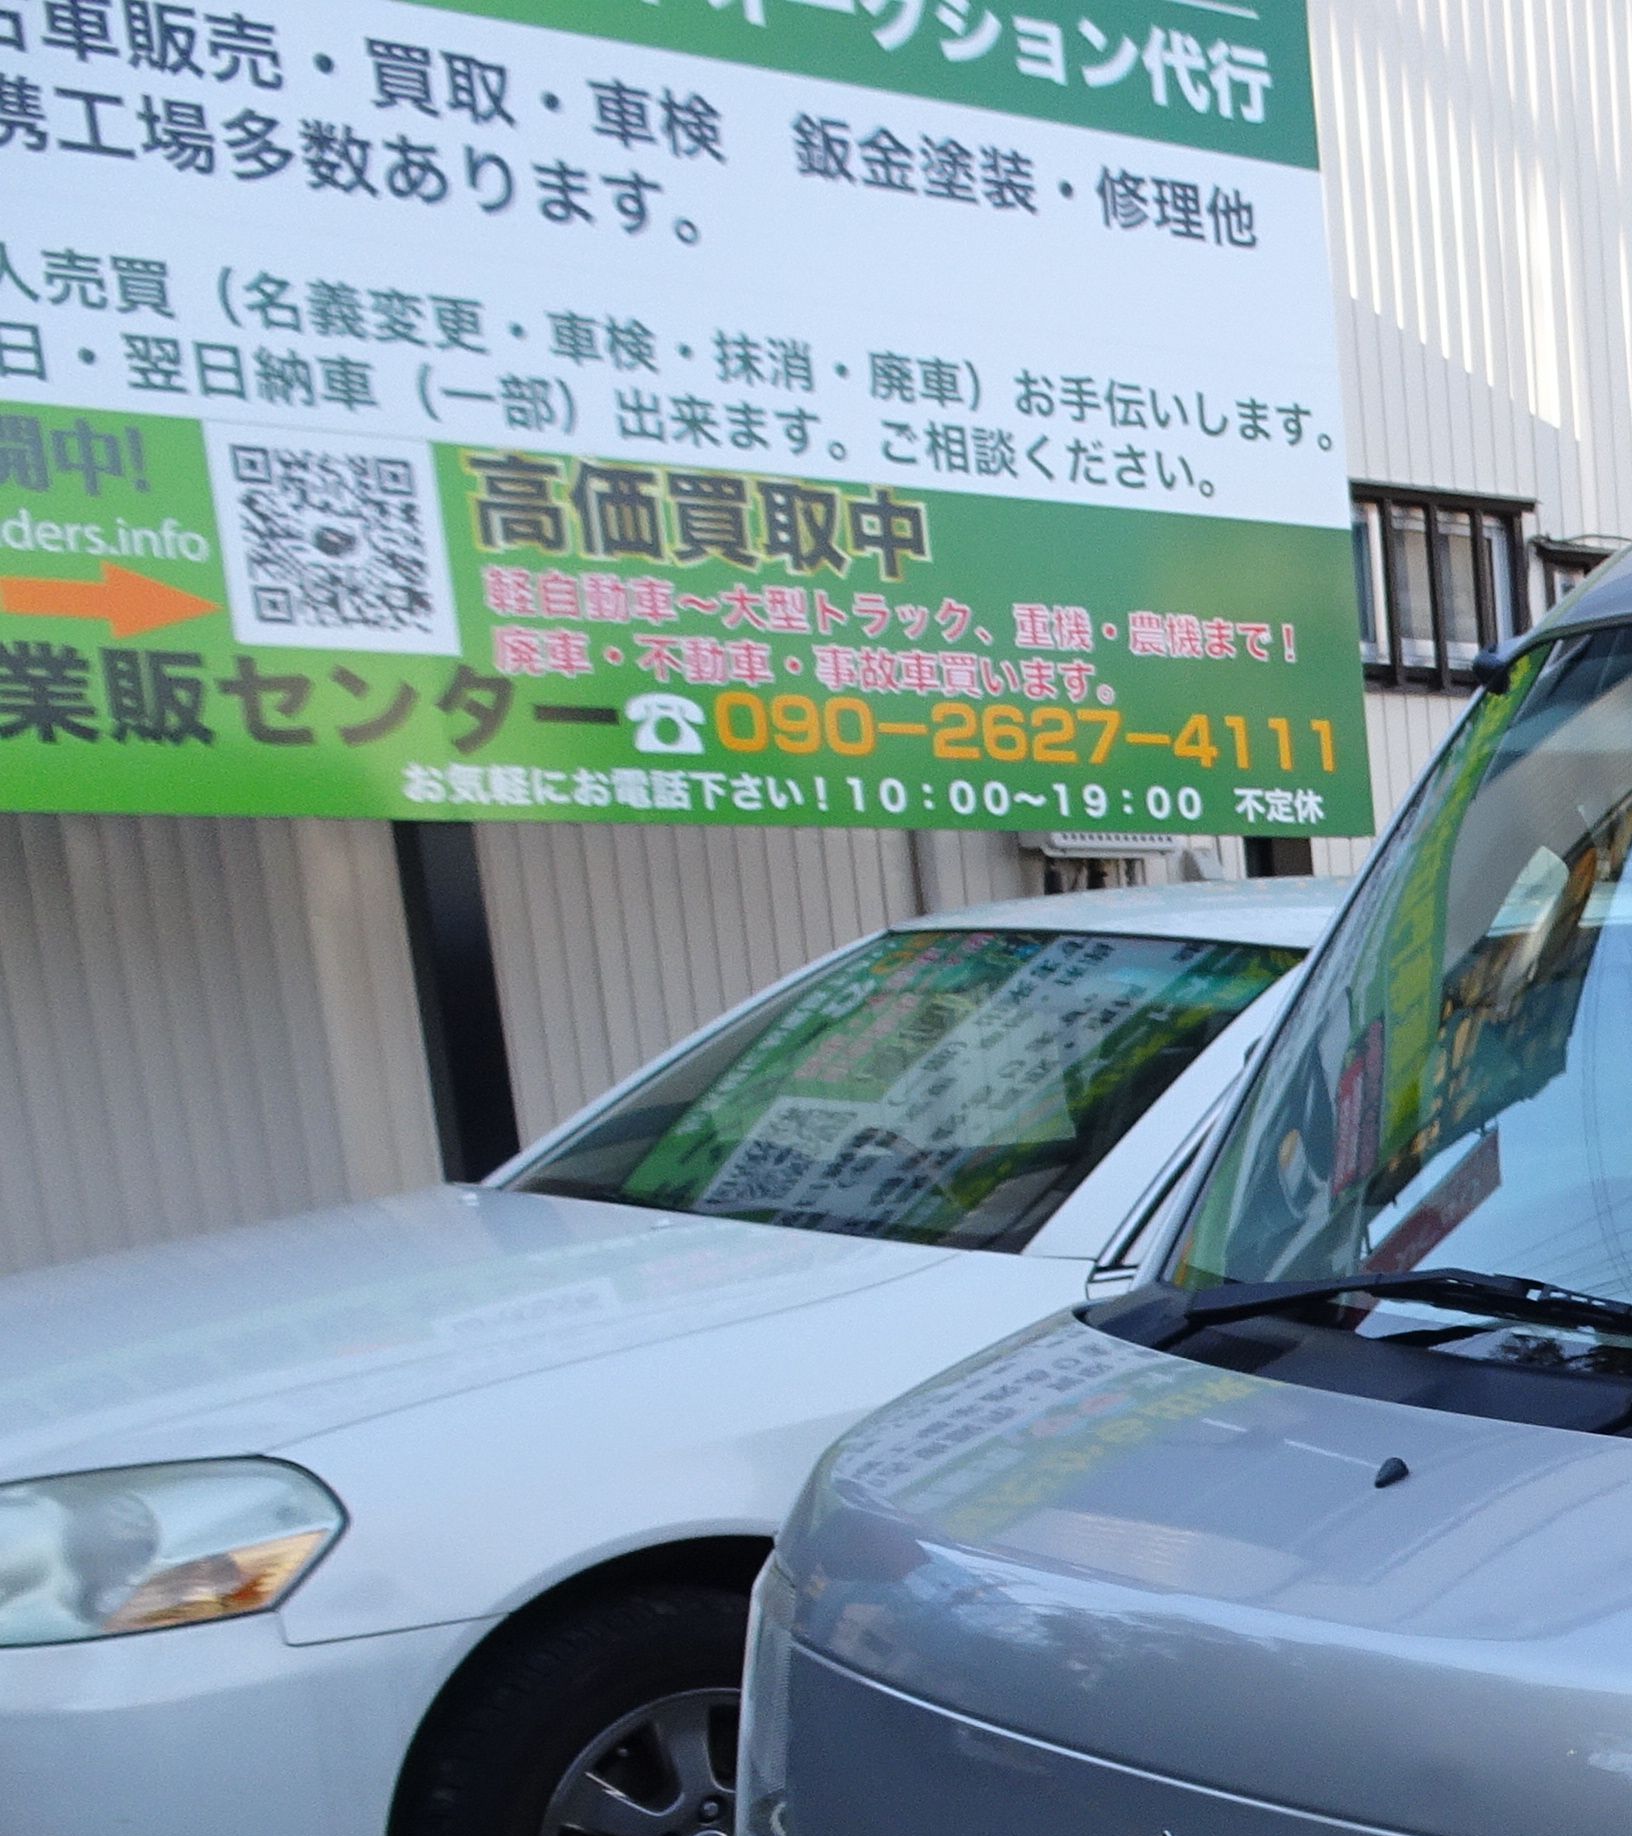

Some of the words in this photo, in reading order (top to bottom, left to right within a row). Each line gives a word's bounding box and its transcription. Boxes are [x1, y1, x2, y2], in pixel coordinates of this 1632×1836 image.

[791, 112, 1258, 250] 鈑金塗装・修理他
[466, 450, 932, 581] 高価買取中
[0, 638, 621, 757] 業販センター
[713, 691, 1339, 774] 090-2627-4111
[490, 626, 1116, 706] 廃車・不動車・事故車買います。
[1233, 786, 1326, 824] 不定休
